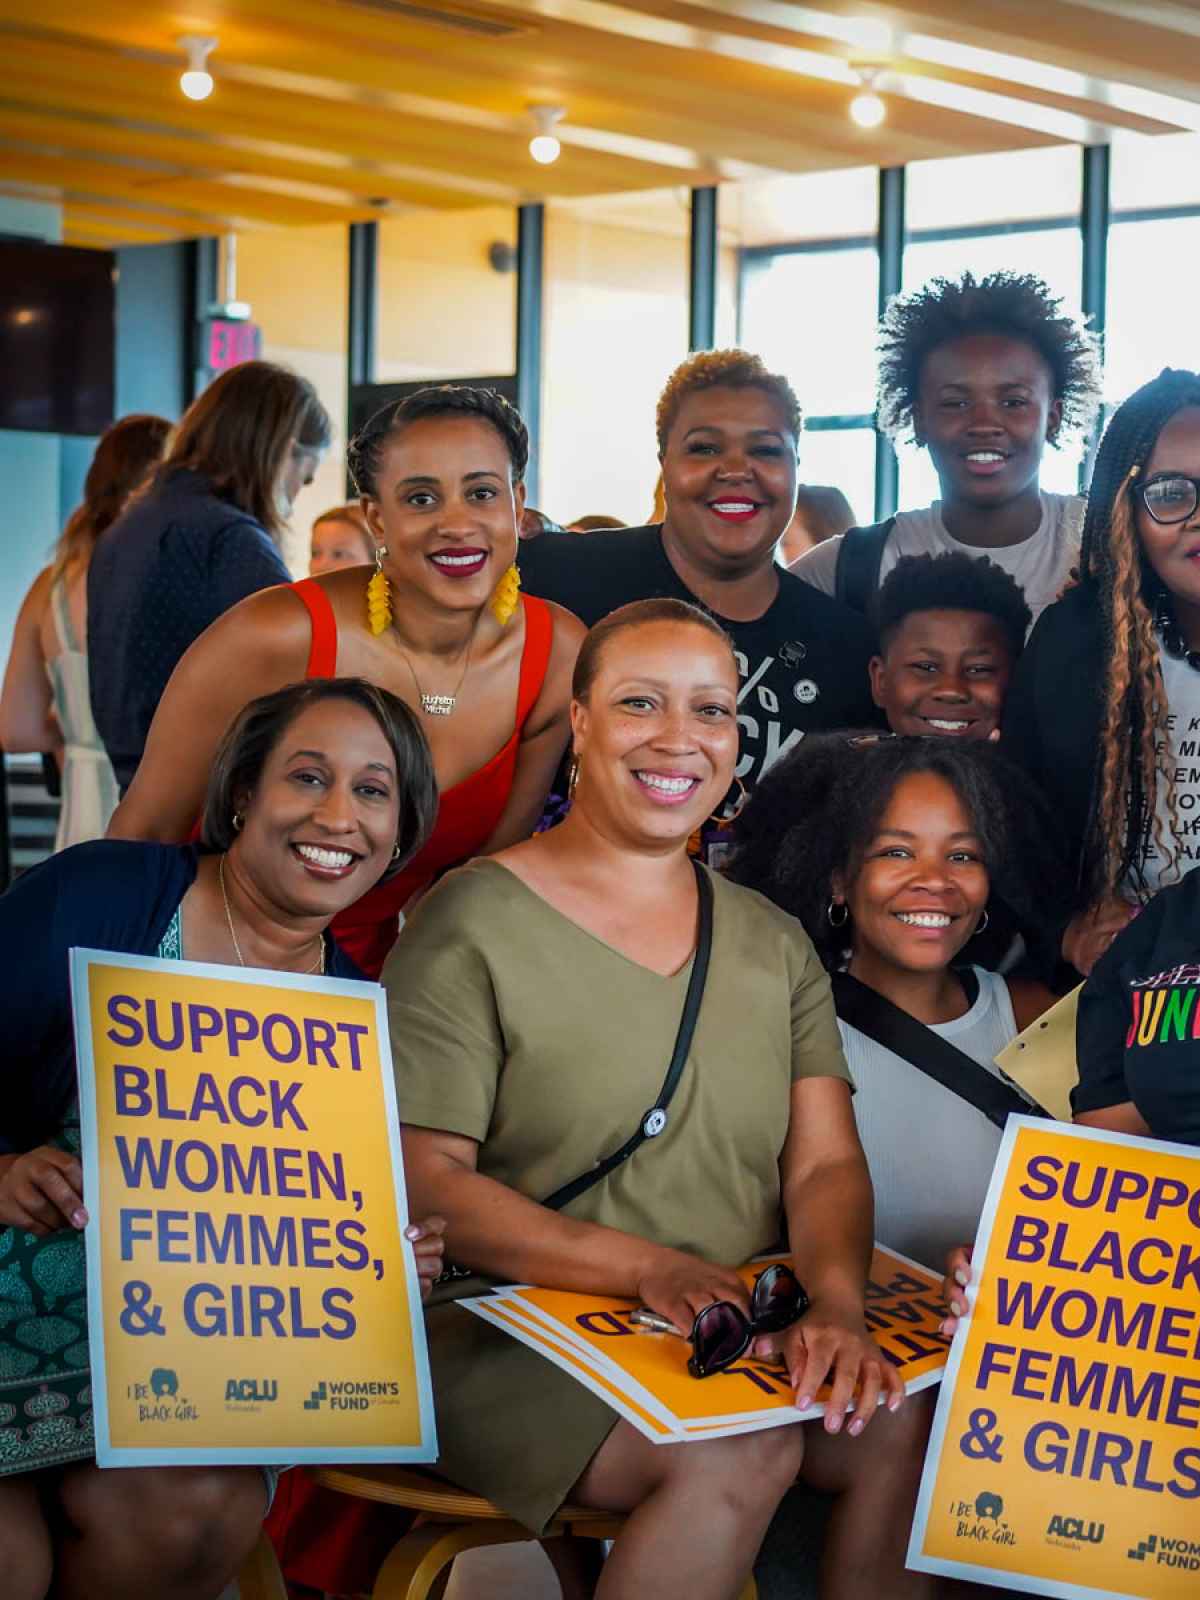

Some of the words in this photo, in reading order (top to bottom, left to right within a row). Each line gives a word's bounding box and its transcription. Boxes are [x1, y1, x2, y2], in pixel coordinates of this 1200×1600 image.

[106, 994, 369, 1071] SUPPORT
[113, 1064, 308, 1132] BLACK
[114, 1135, 363, 1211] WOMEN,
[117, 1206, 384, 1280] FEMMES,
[119, 1280, 167, 1338] &
[182, 1281, 357, 1340] GIRLS
[224, 1378, 278, 1402] ACLU
[328, 1381, 400, 1396] WOMEN'S
[329, 1396, 370, 1411] FUND
[960, 1408, 1004, 1463] &
[957, 1501, 974, 1518] BE
[956, 1521, 990, 1541] BLACK
[992, 1526, 1017, 1545] GIRL
[1046, 1514, 1105, 1545] ACLU
[1156, 1554, 1200, 1572] FUND
